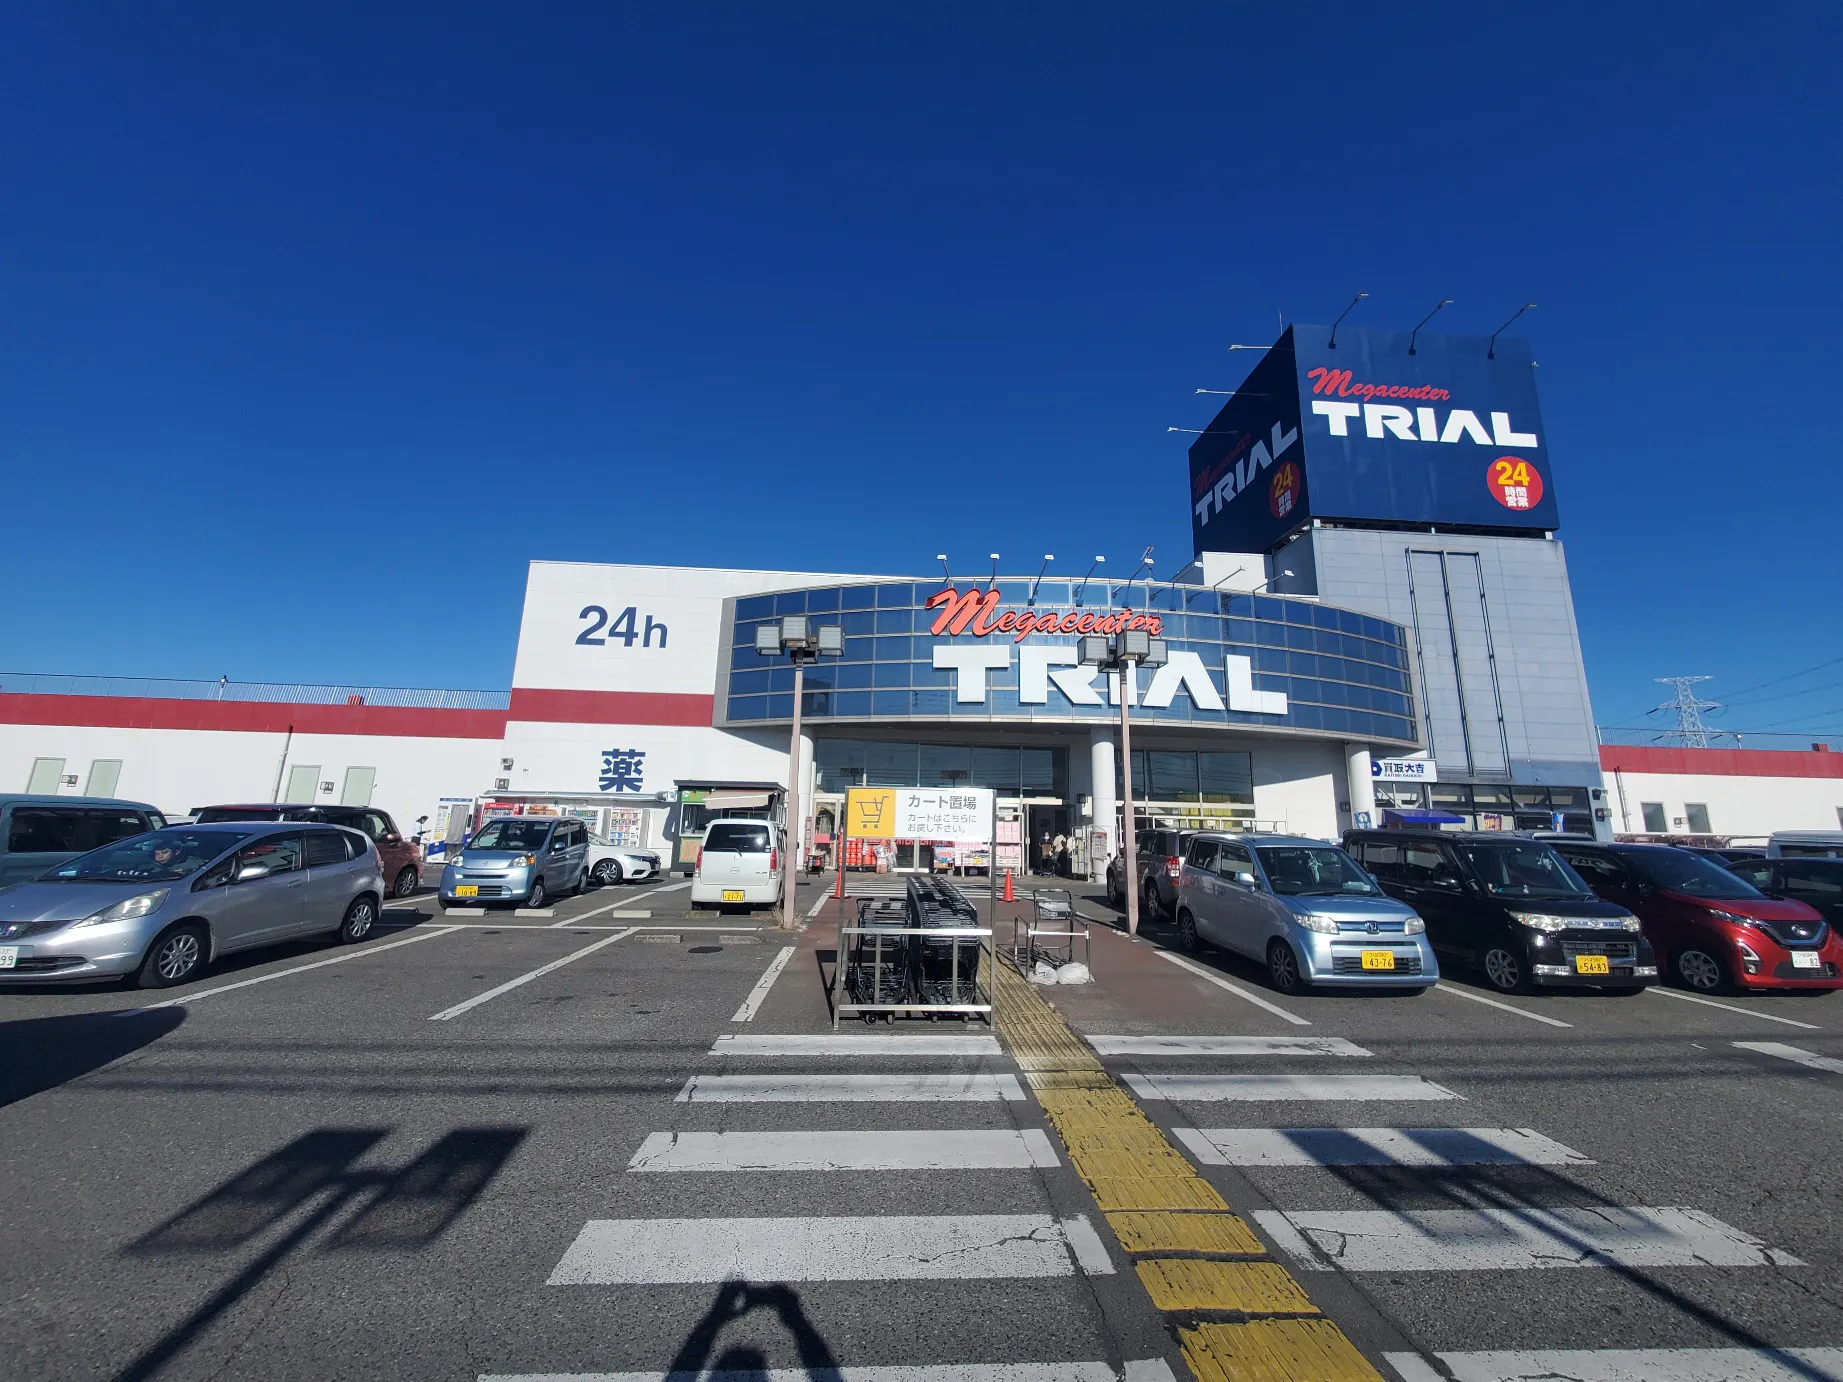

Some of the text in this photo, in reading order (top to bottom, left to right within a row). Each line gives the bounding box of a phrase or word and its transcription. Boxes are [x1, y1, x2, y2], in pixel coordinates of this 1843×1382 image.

[1307, 367, 1451, 402] Megacenter
[1311, 400, 1538, 448] TRIAL
[1195, 420, 1298, 527] TRIAL
[1273, 463, 1294, 499] 24
[1495, 461, 1530, 487] 24
[575, 604, 668, 649] 24h
[925, 587, 1165, 643] Megacenter
[598, 748, 646, 793] 薬
[1383, 761, 1424, 774] 買取大吉
[907, 814, 977, 823] カートはこちらに
[908, 795, 977, 809] カート置場
[907, 824, 966, 833] お戻し下さい。
